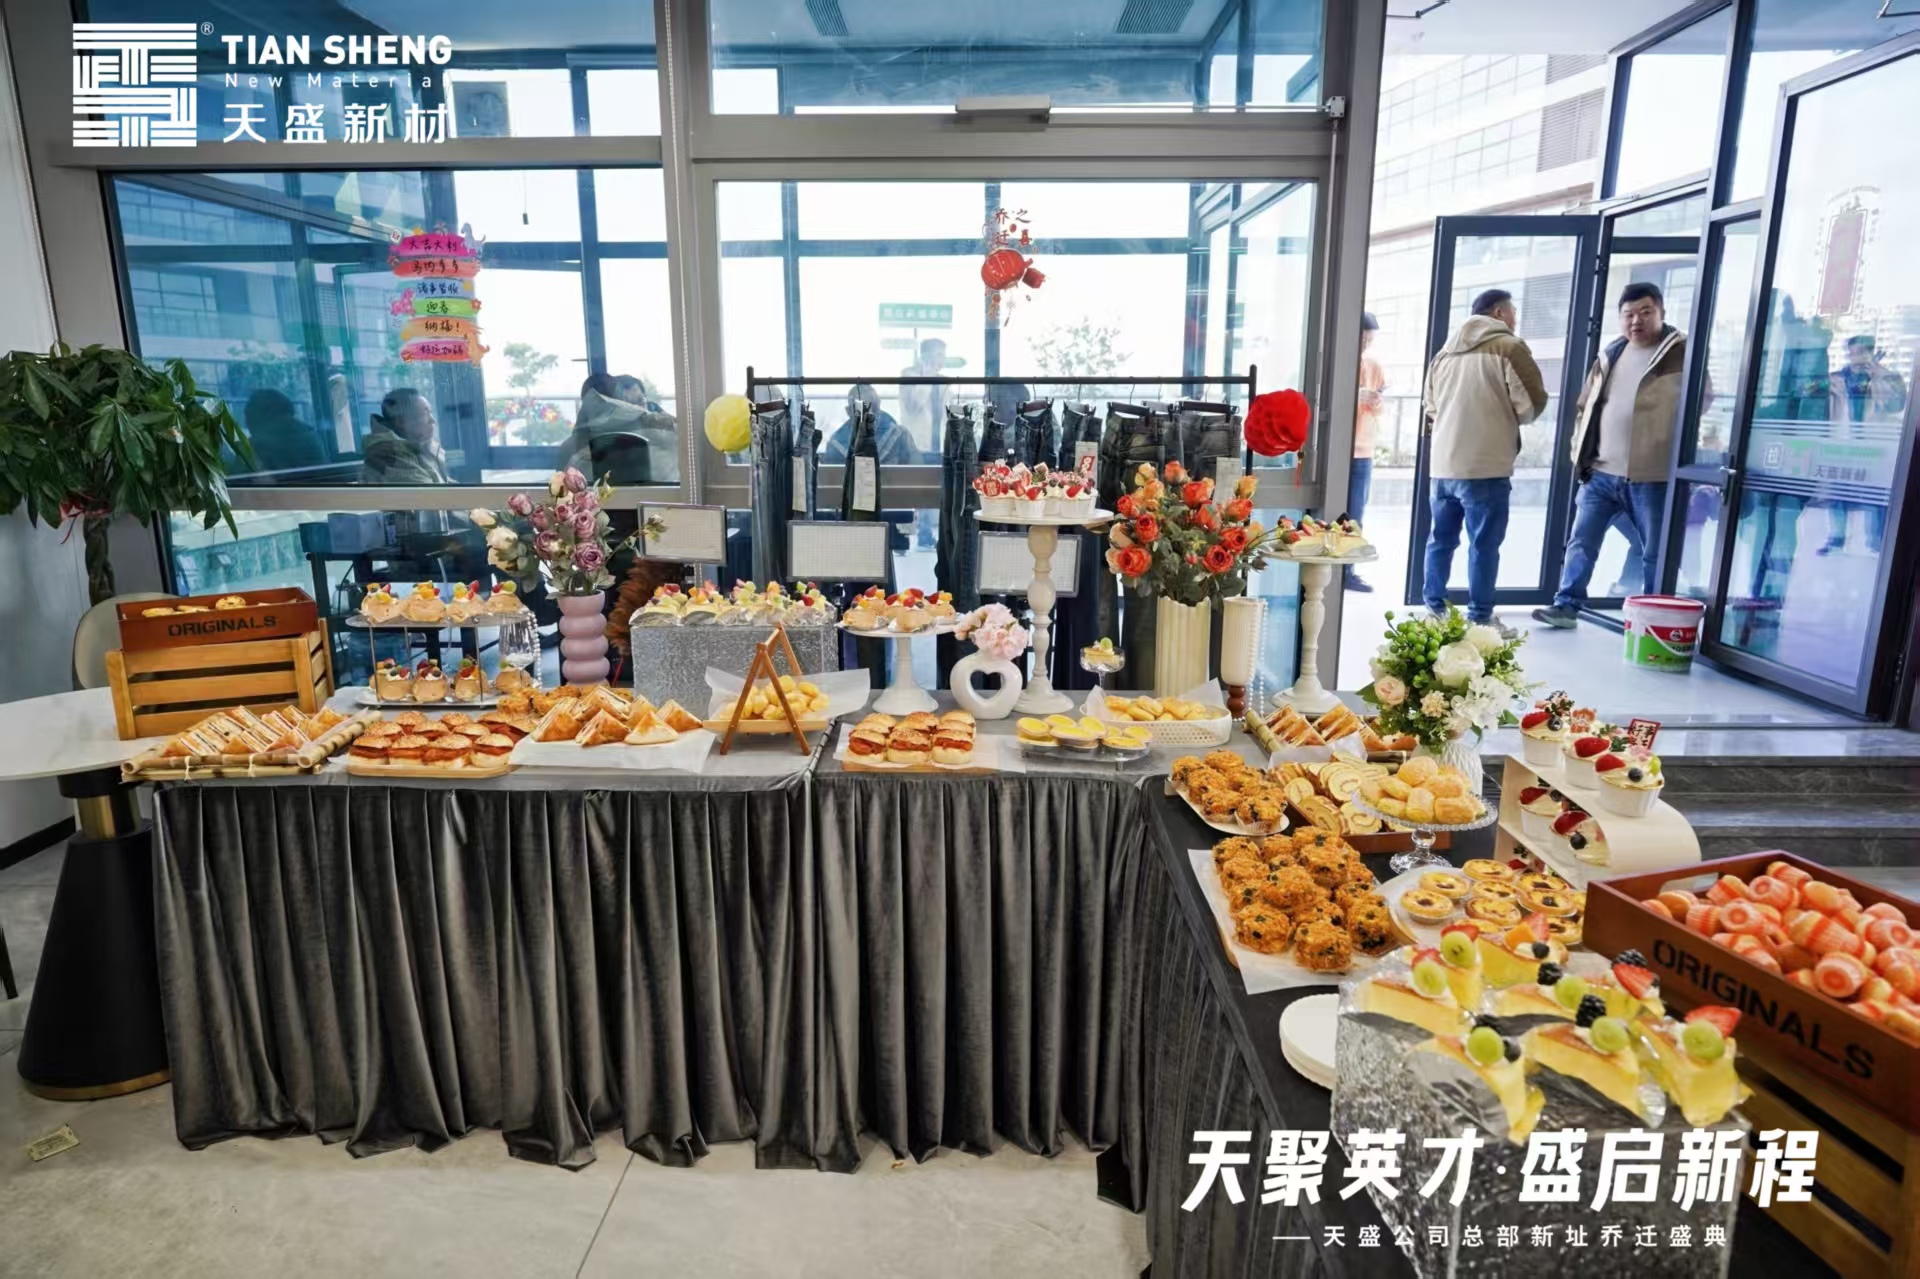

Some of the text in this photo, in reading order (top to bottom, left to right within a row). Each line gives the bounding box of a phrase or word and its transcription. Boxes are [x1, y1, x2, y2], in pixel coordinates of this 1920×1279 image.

[409, 238, 457, 252] 大吉大利
[426, 300, 449, 314] 迎春
[167, 615, 277, 637] ORIGINALS
[1653, 939, 1874, 1079] ORIGINALS
